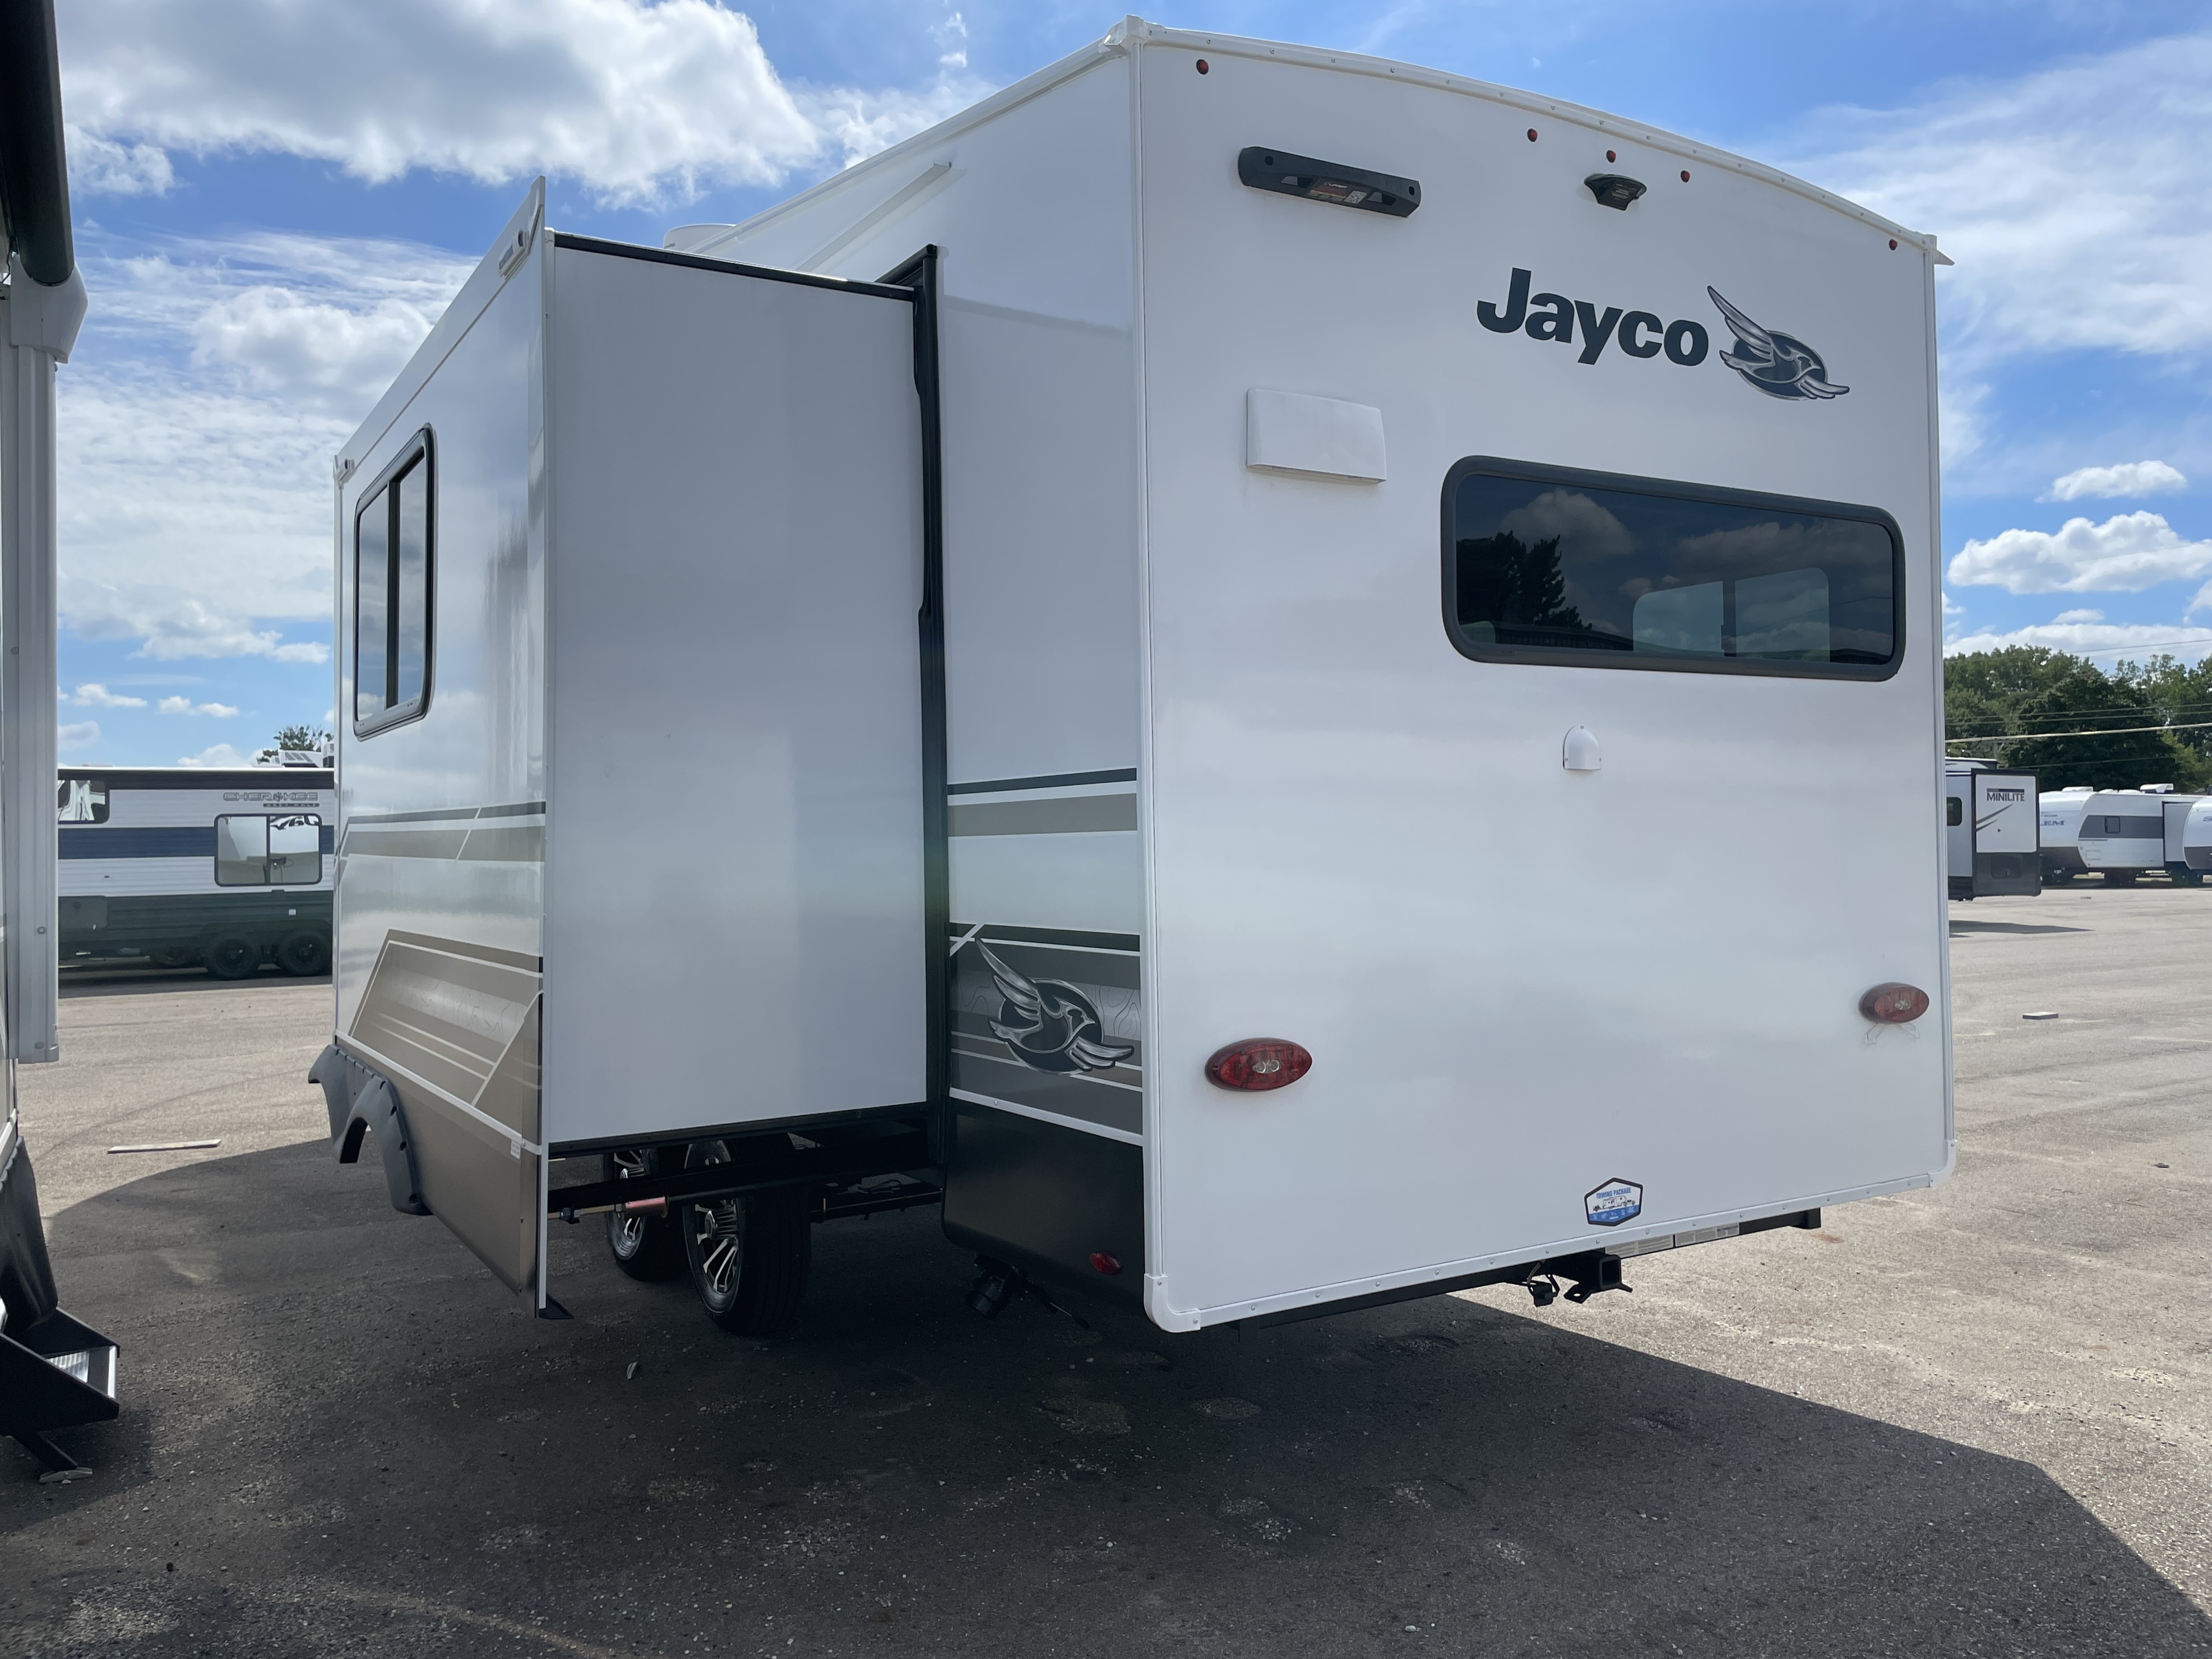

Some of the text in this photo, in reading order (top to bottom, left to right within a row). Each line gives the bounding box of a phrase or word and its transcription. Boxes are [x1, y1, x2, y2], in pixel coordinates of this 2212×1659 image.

[1477, 267, 1709, 366] Jayco
[224, 792, 318, 801] CHEROKEE
[1987, 793, 2024, 801] MINILITE
[1613, 1187, 1631, 1195] PACKAGE
